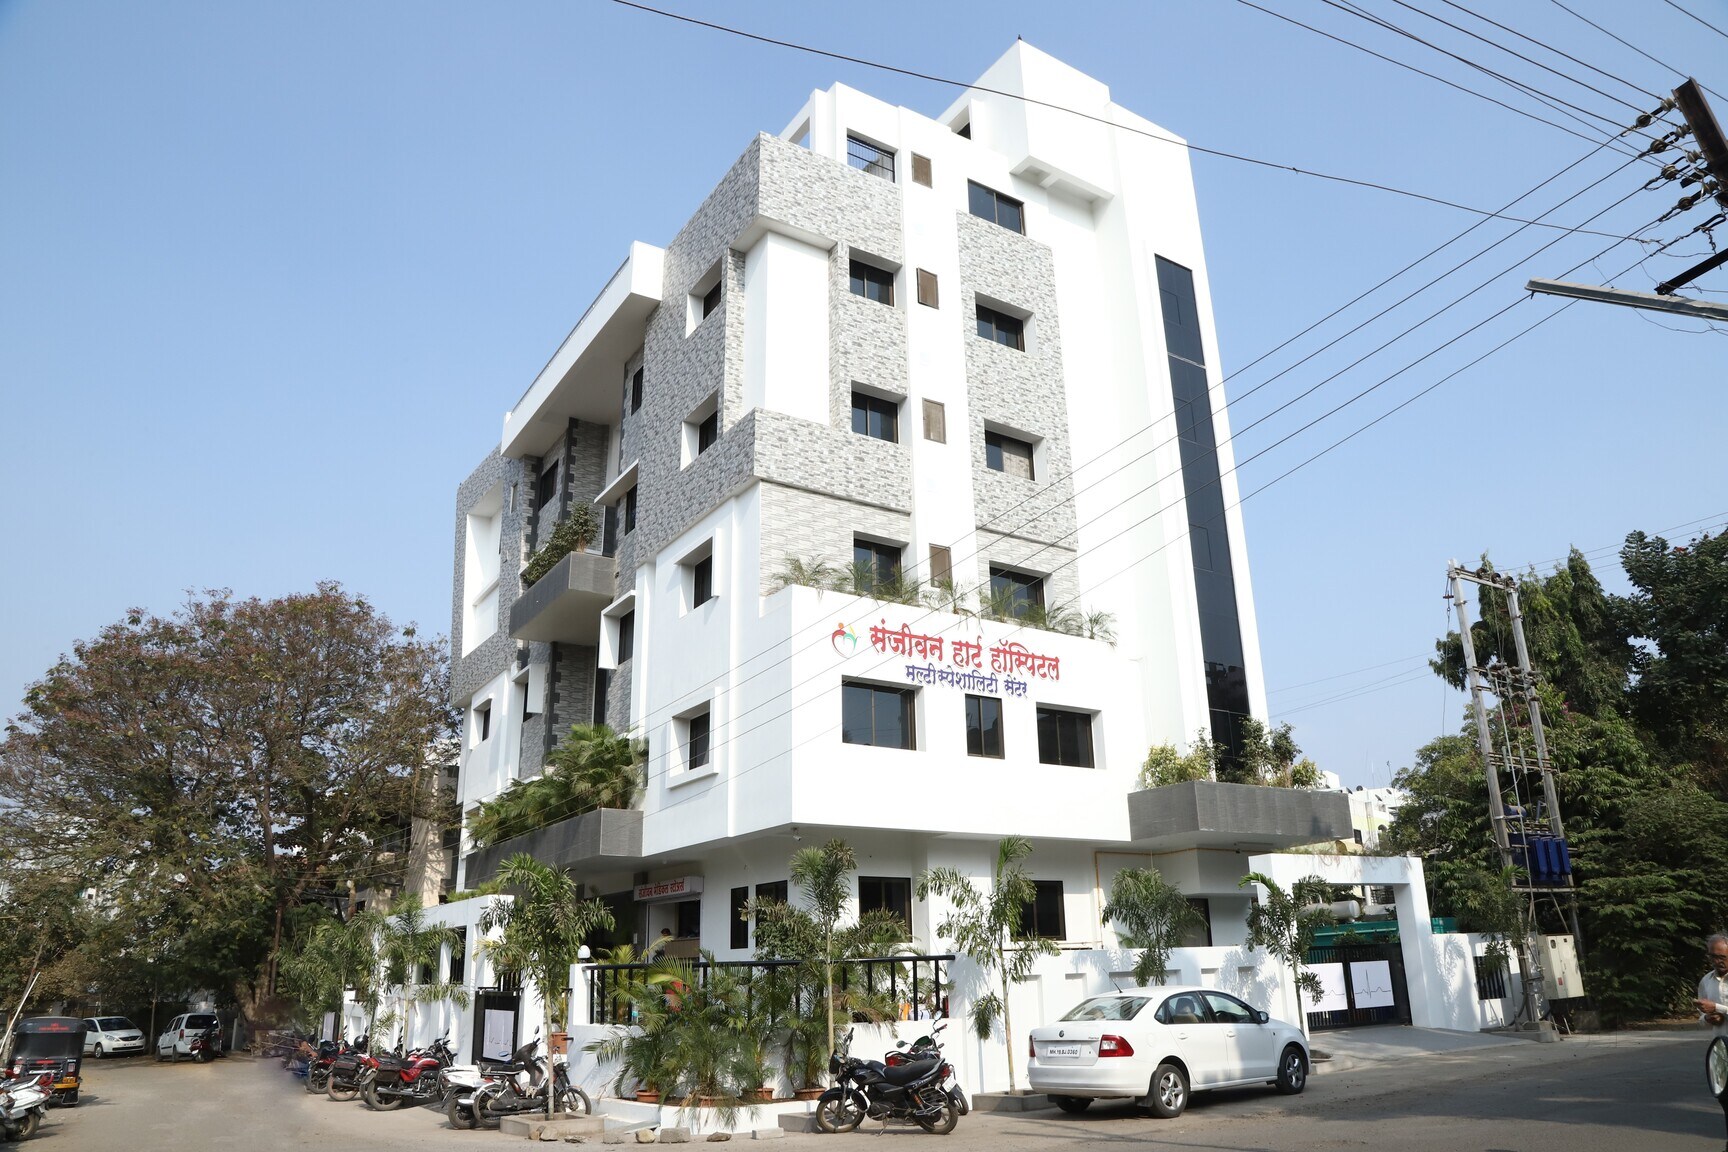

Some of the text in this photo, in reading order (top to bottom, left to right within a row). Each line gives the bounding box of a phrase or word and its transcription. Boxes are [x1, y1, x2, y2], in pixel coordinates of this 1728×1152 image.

[869, 618, 1060, 681] संजीवन हार्ट हॉस्पिटल
[1003, 674, 1028, 698] सेंटर
